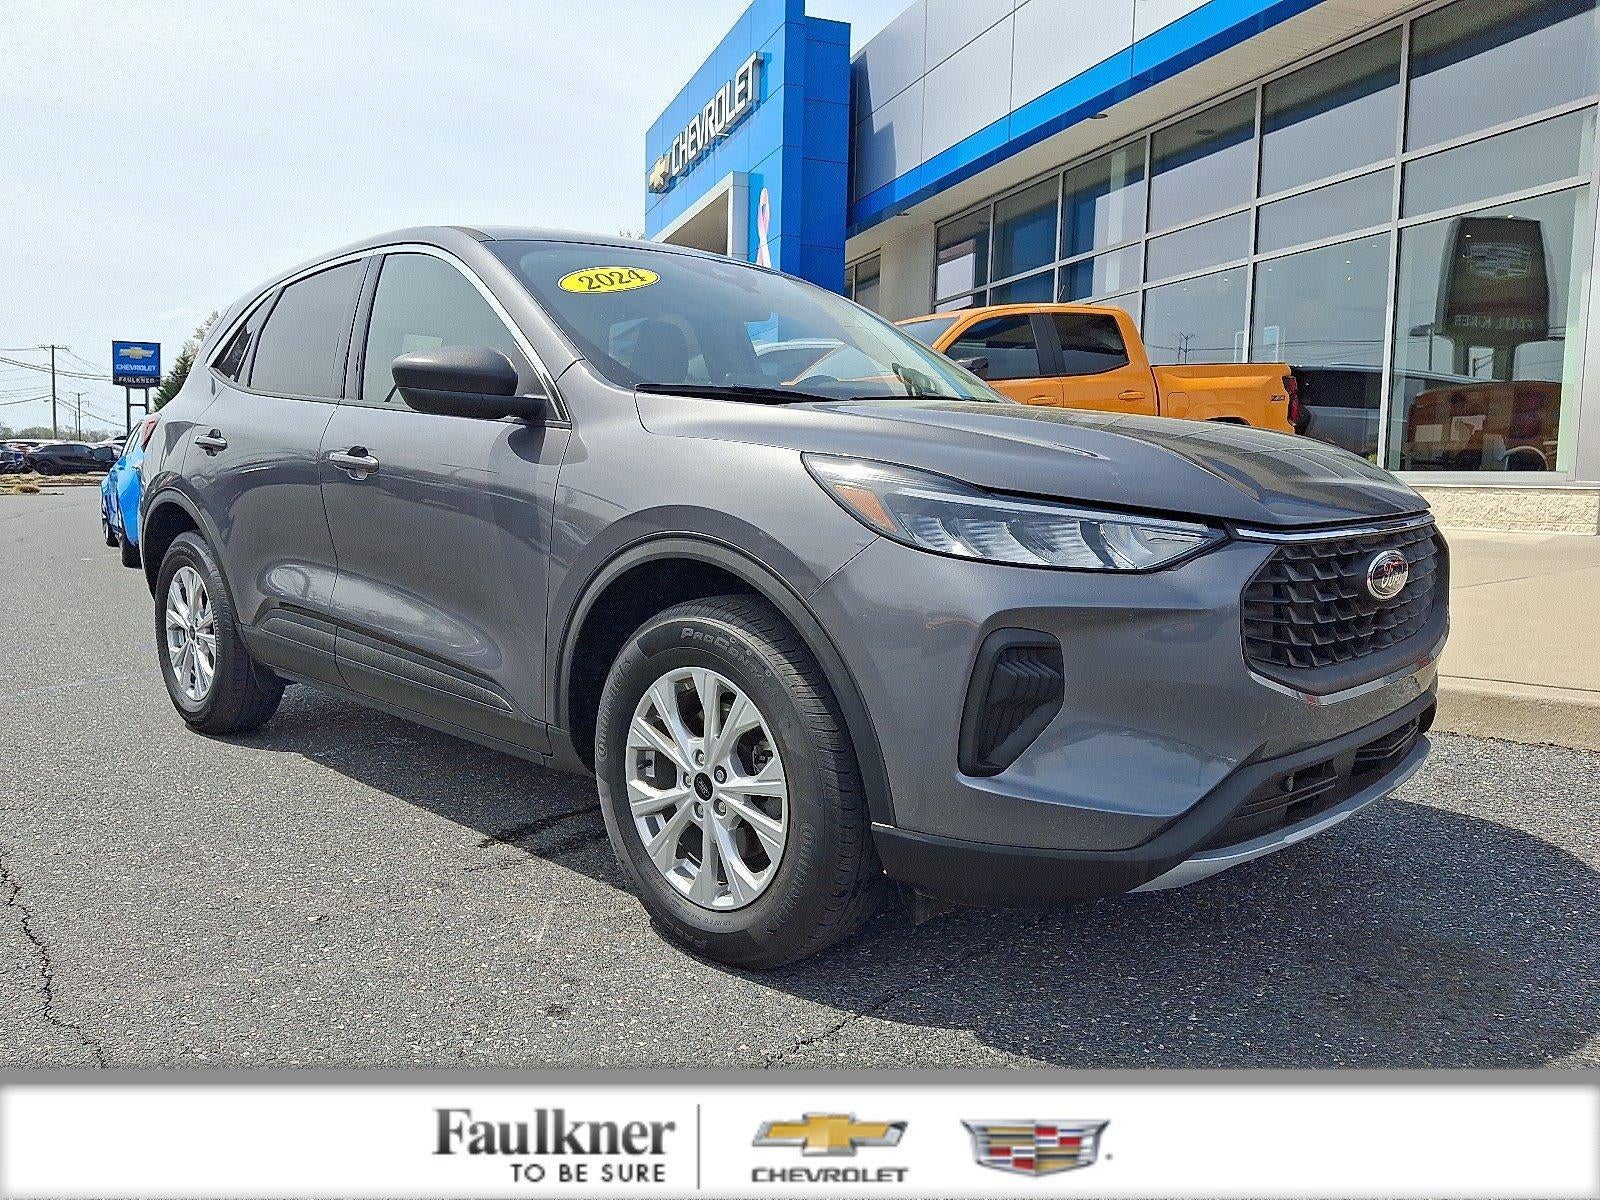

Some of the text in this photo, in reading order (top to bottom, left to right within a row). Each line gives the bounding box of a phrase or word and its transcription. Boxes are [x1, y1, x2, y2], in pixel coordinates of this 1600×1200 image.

[671, 51, 760, 176] CHEVROLET
[578, 269, 647, 291] 2024
[115, 364, 156, 372] CHEVROLET
